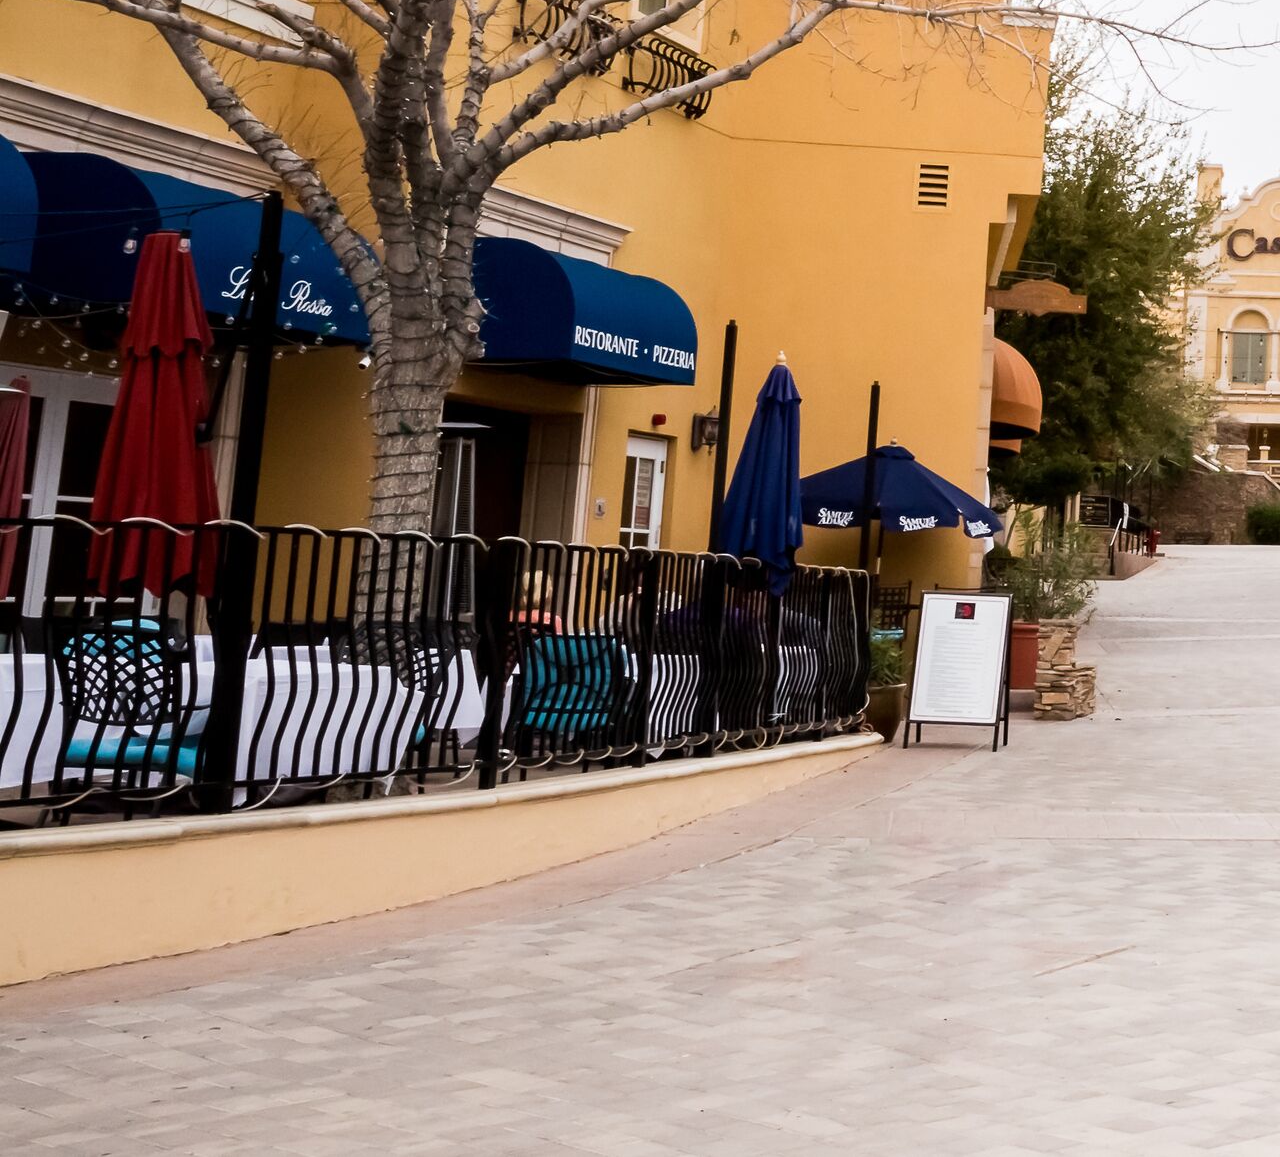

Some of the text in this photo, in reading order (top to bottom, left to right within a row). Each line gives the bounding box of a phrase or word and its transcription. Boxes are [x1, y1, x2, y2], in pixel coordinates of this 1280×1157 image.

[281, 280, 333, 317] Rossa
[574, 325, 695, 371] RISTORANTE PIZZERIA
